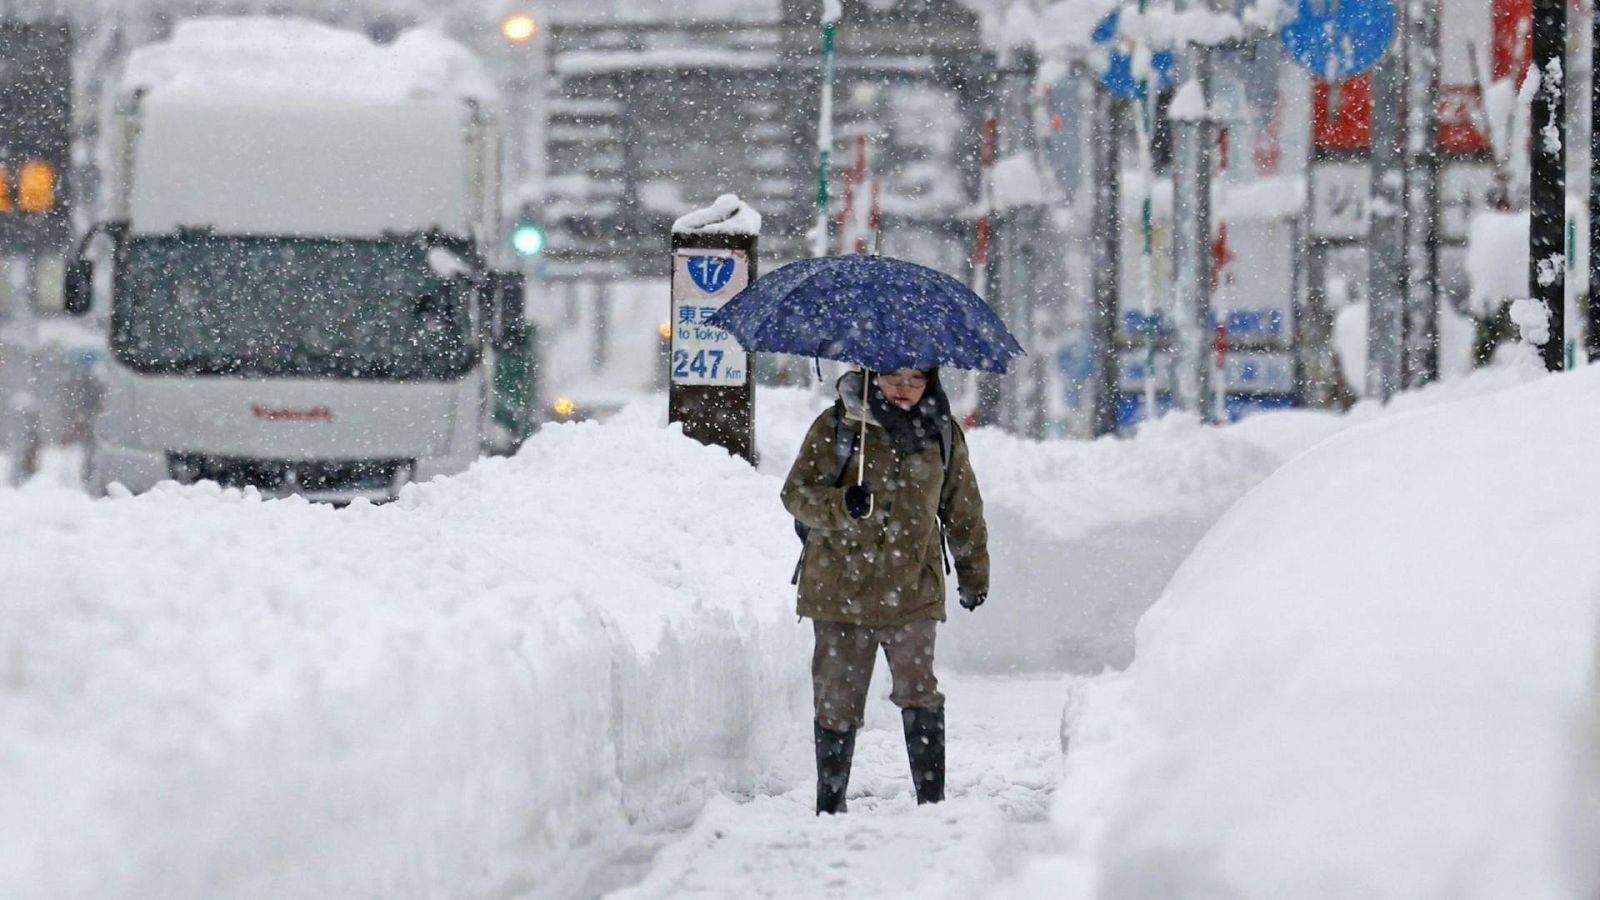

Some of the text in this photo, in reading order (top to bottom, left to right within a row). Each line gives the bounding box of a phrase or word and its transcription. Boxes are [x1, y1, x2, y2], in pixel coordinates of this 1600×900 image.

[698, 256, 724, 285] 17
[678, 327, 728, 343] to Tokyo
[673, 349, 724, 379] 247
